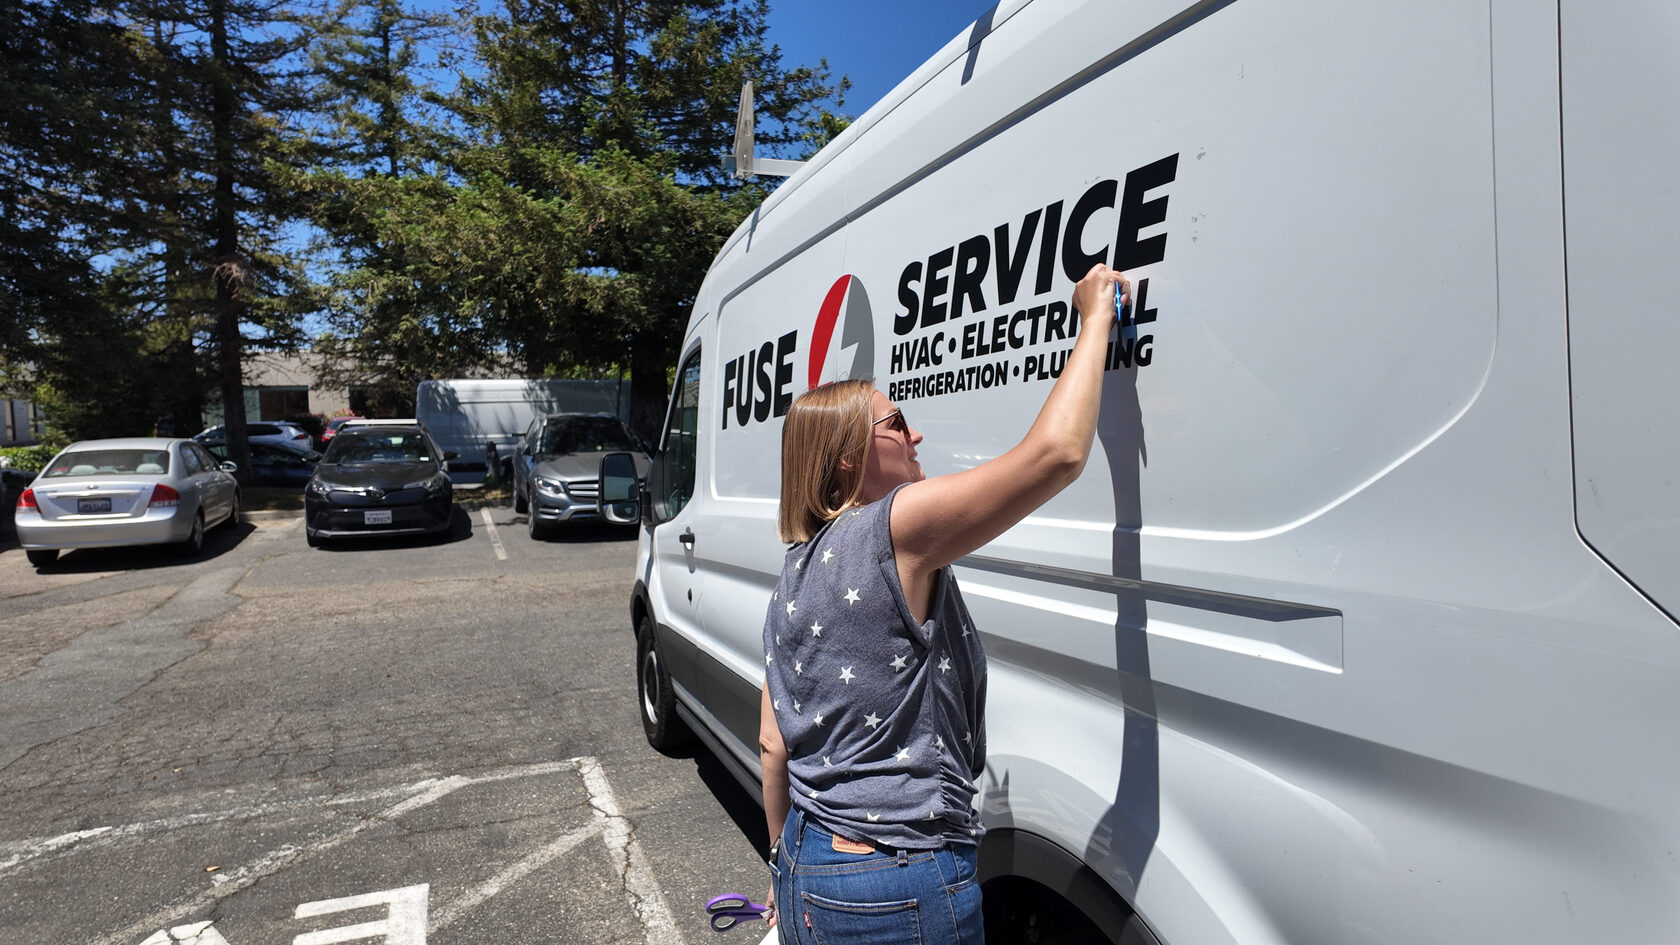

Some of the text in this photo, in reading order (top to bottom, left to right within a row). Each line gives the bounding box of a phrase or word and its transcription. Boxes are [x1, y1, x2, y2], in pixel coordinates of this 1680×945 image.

[893, 152, 1179, 335] SERVICE
[889, 334, 1154, 402] REFRIGERATION PLUING
[890, 278, 1158, 375] HVAC ELECTRIL
[722, 329, 798, 430] FUSE
